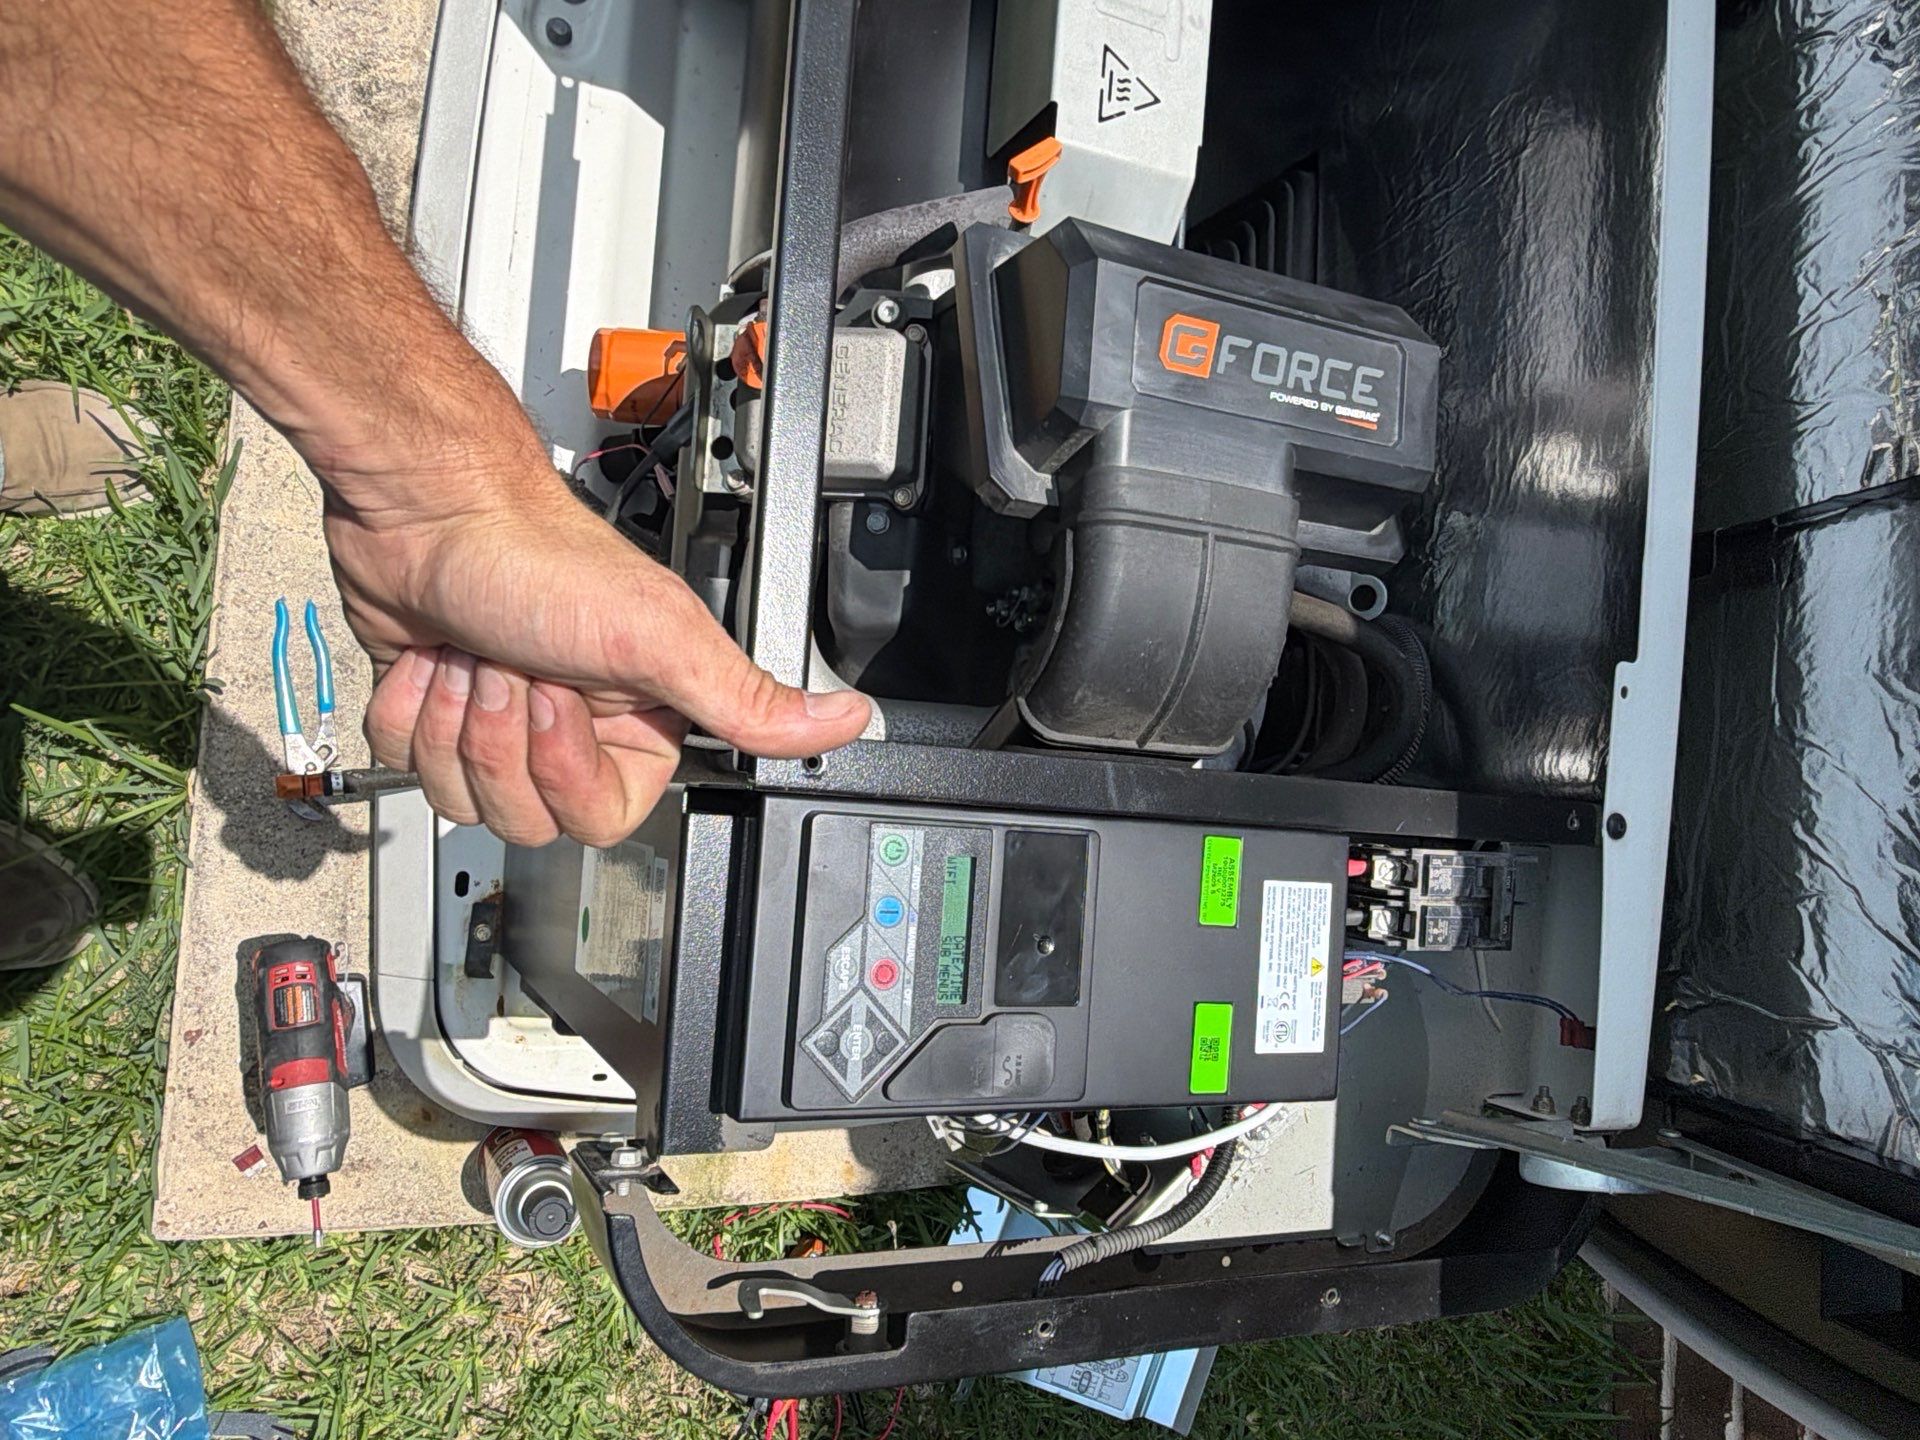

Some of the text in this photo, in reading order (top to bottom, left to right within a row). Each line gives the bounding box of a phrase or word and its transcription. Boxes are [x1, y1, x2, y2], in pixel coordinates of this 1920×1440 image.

[829, 344, 851, 454] GENERAC
[1270, 391, 1318, 410] POWERED
[1320, 402, 1334, 412] BY
[911, 865, 921, 891] AUTO
[1226, 858, 1236, 909] ASSEMBLY
[905, 926, 918, 963] MANUAL
[940, 936, 952, 959] SUB
[838, 946, 851, 992] ESCAPE
[936, 964, 950, 1001] MENUS
[949, 935, 967, 1001] DATE/TIME
[902, 988, 912, 1005] OFF
[850, 1023, 863, 1061] ENTER
